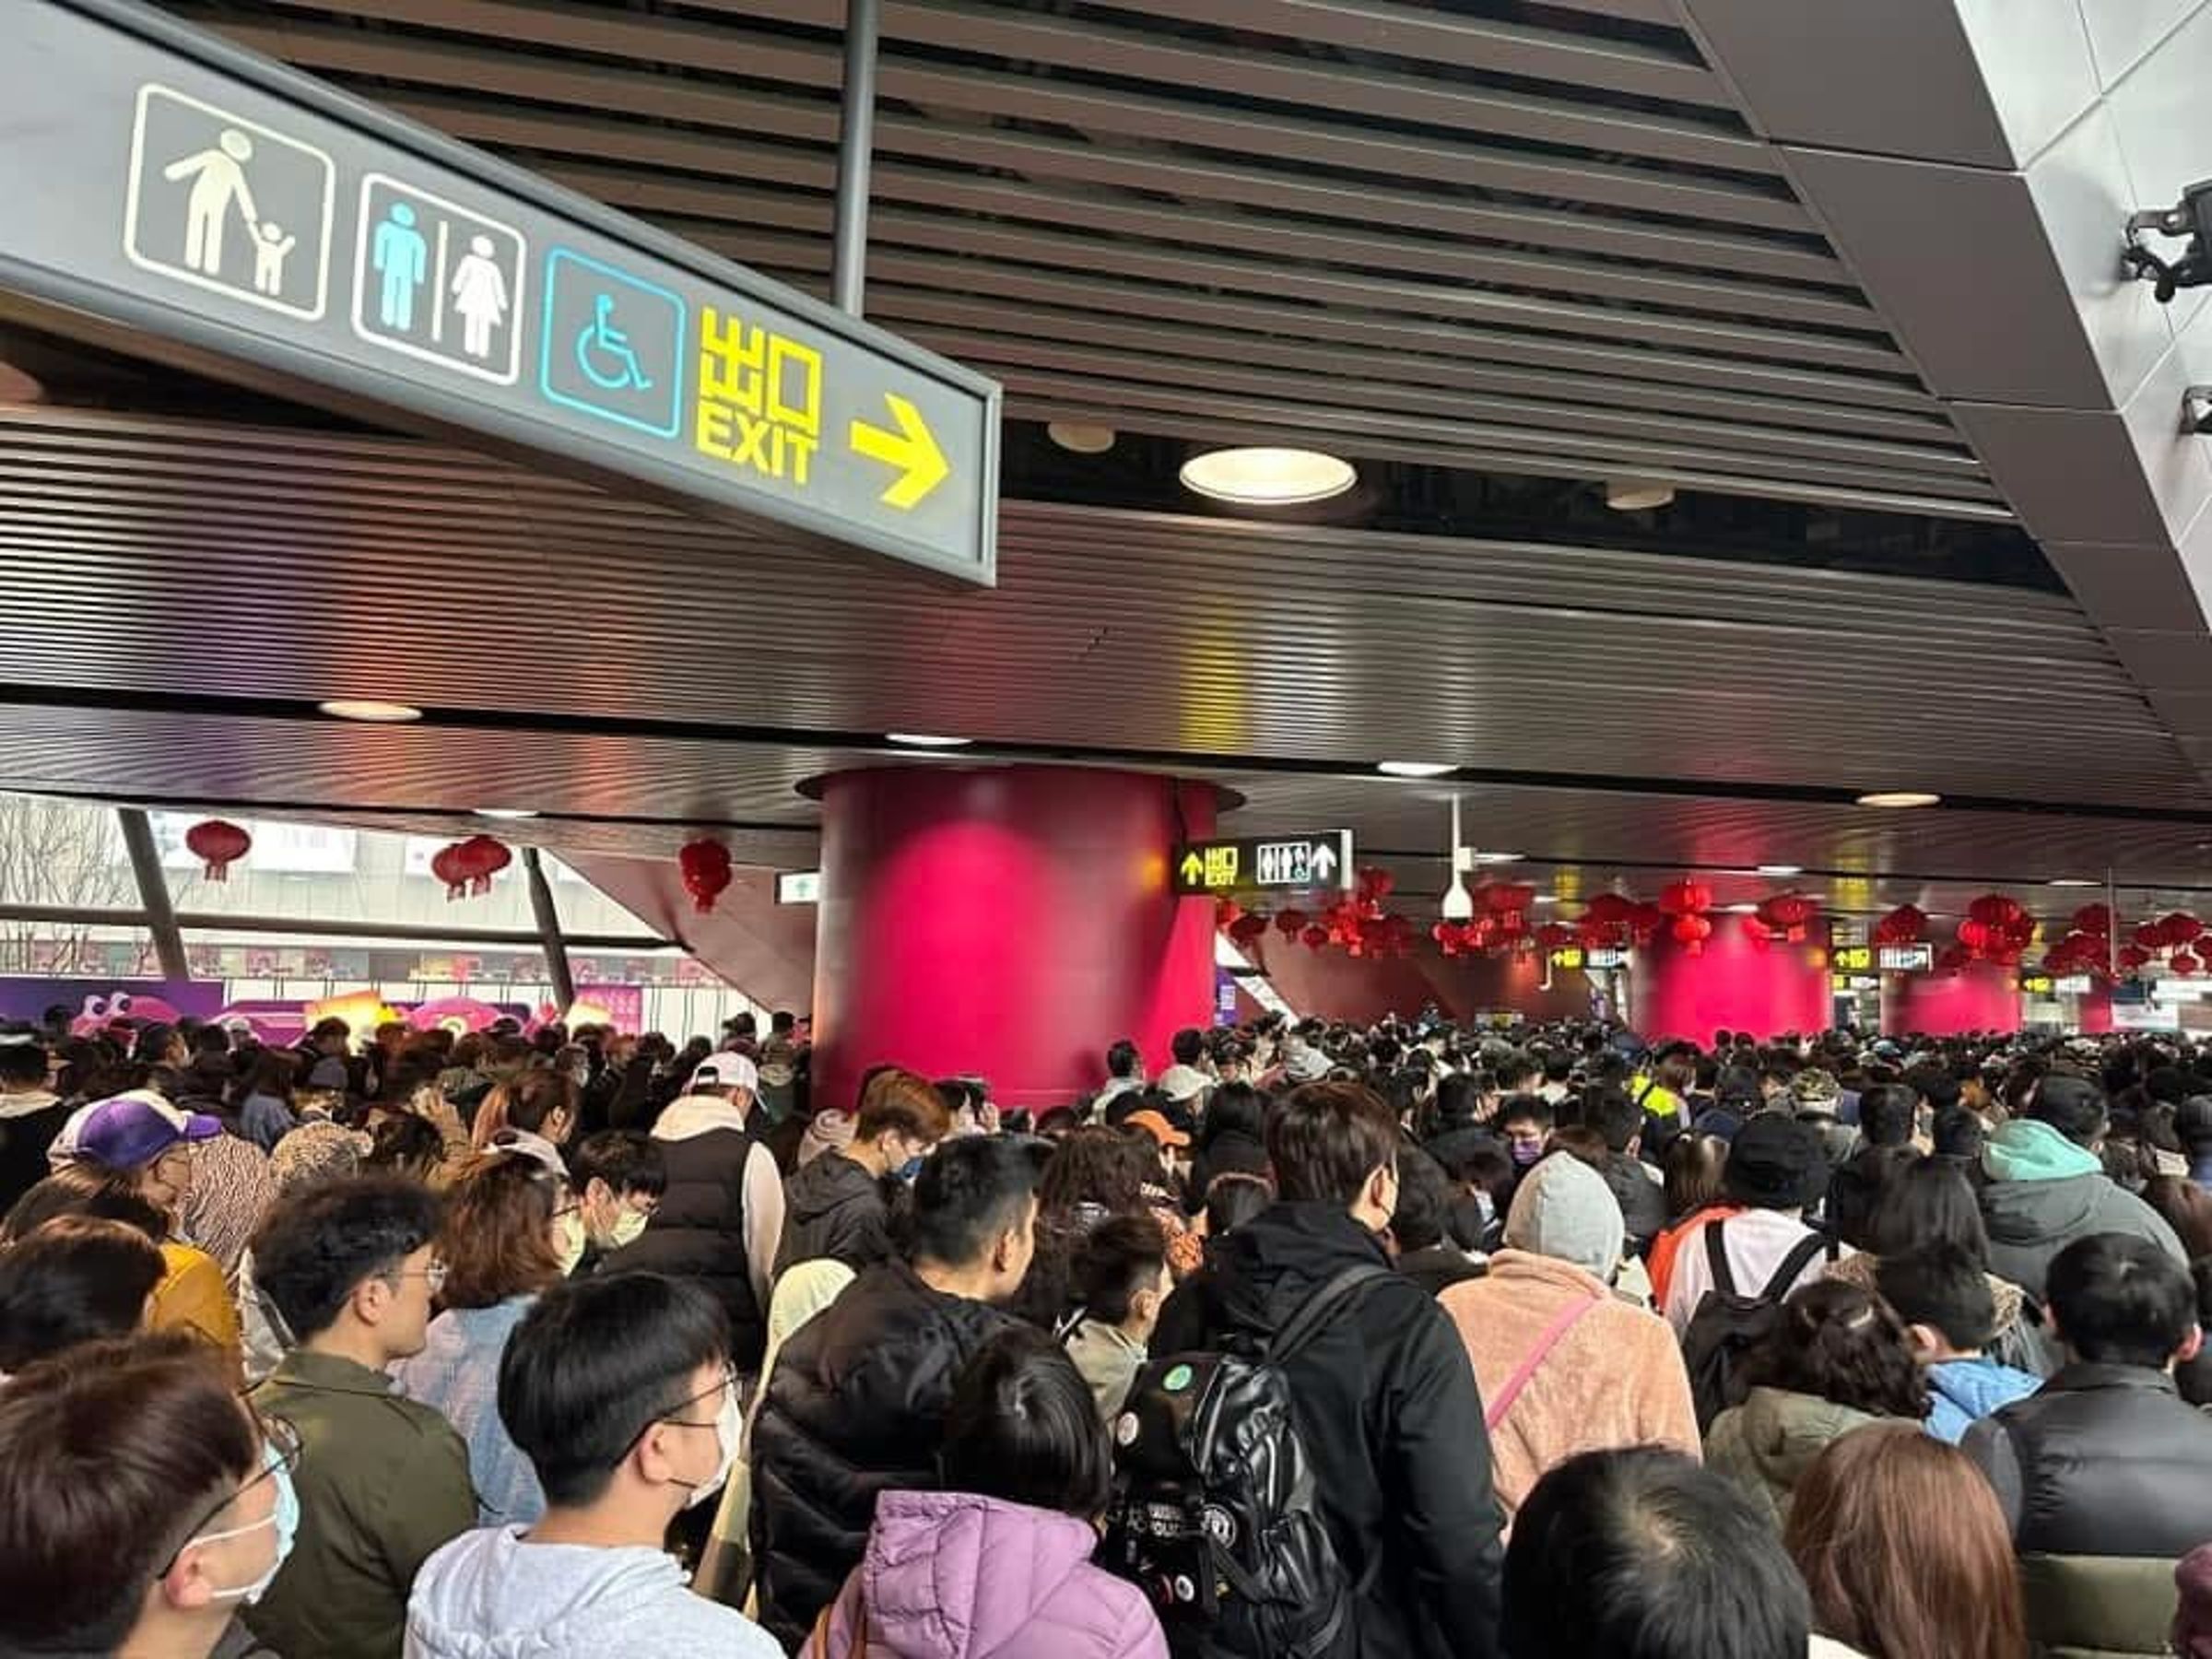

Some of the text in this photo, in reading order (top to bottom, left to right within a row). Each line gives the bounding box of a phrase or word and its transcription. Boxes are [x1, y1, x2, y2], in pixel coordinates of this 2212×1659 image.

[700, 307, 821, 435] 出口
[697, 399, 818, 484] EXIT
[1205, 847, 1238, 869] 出口
